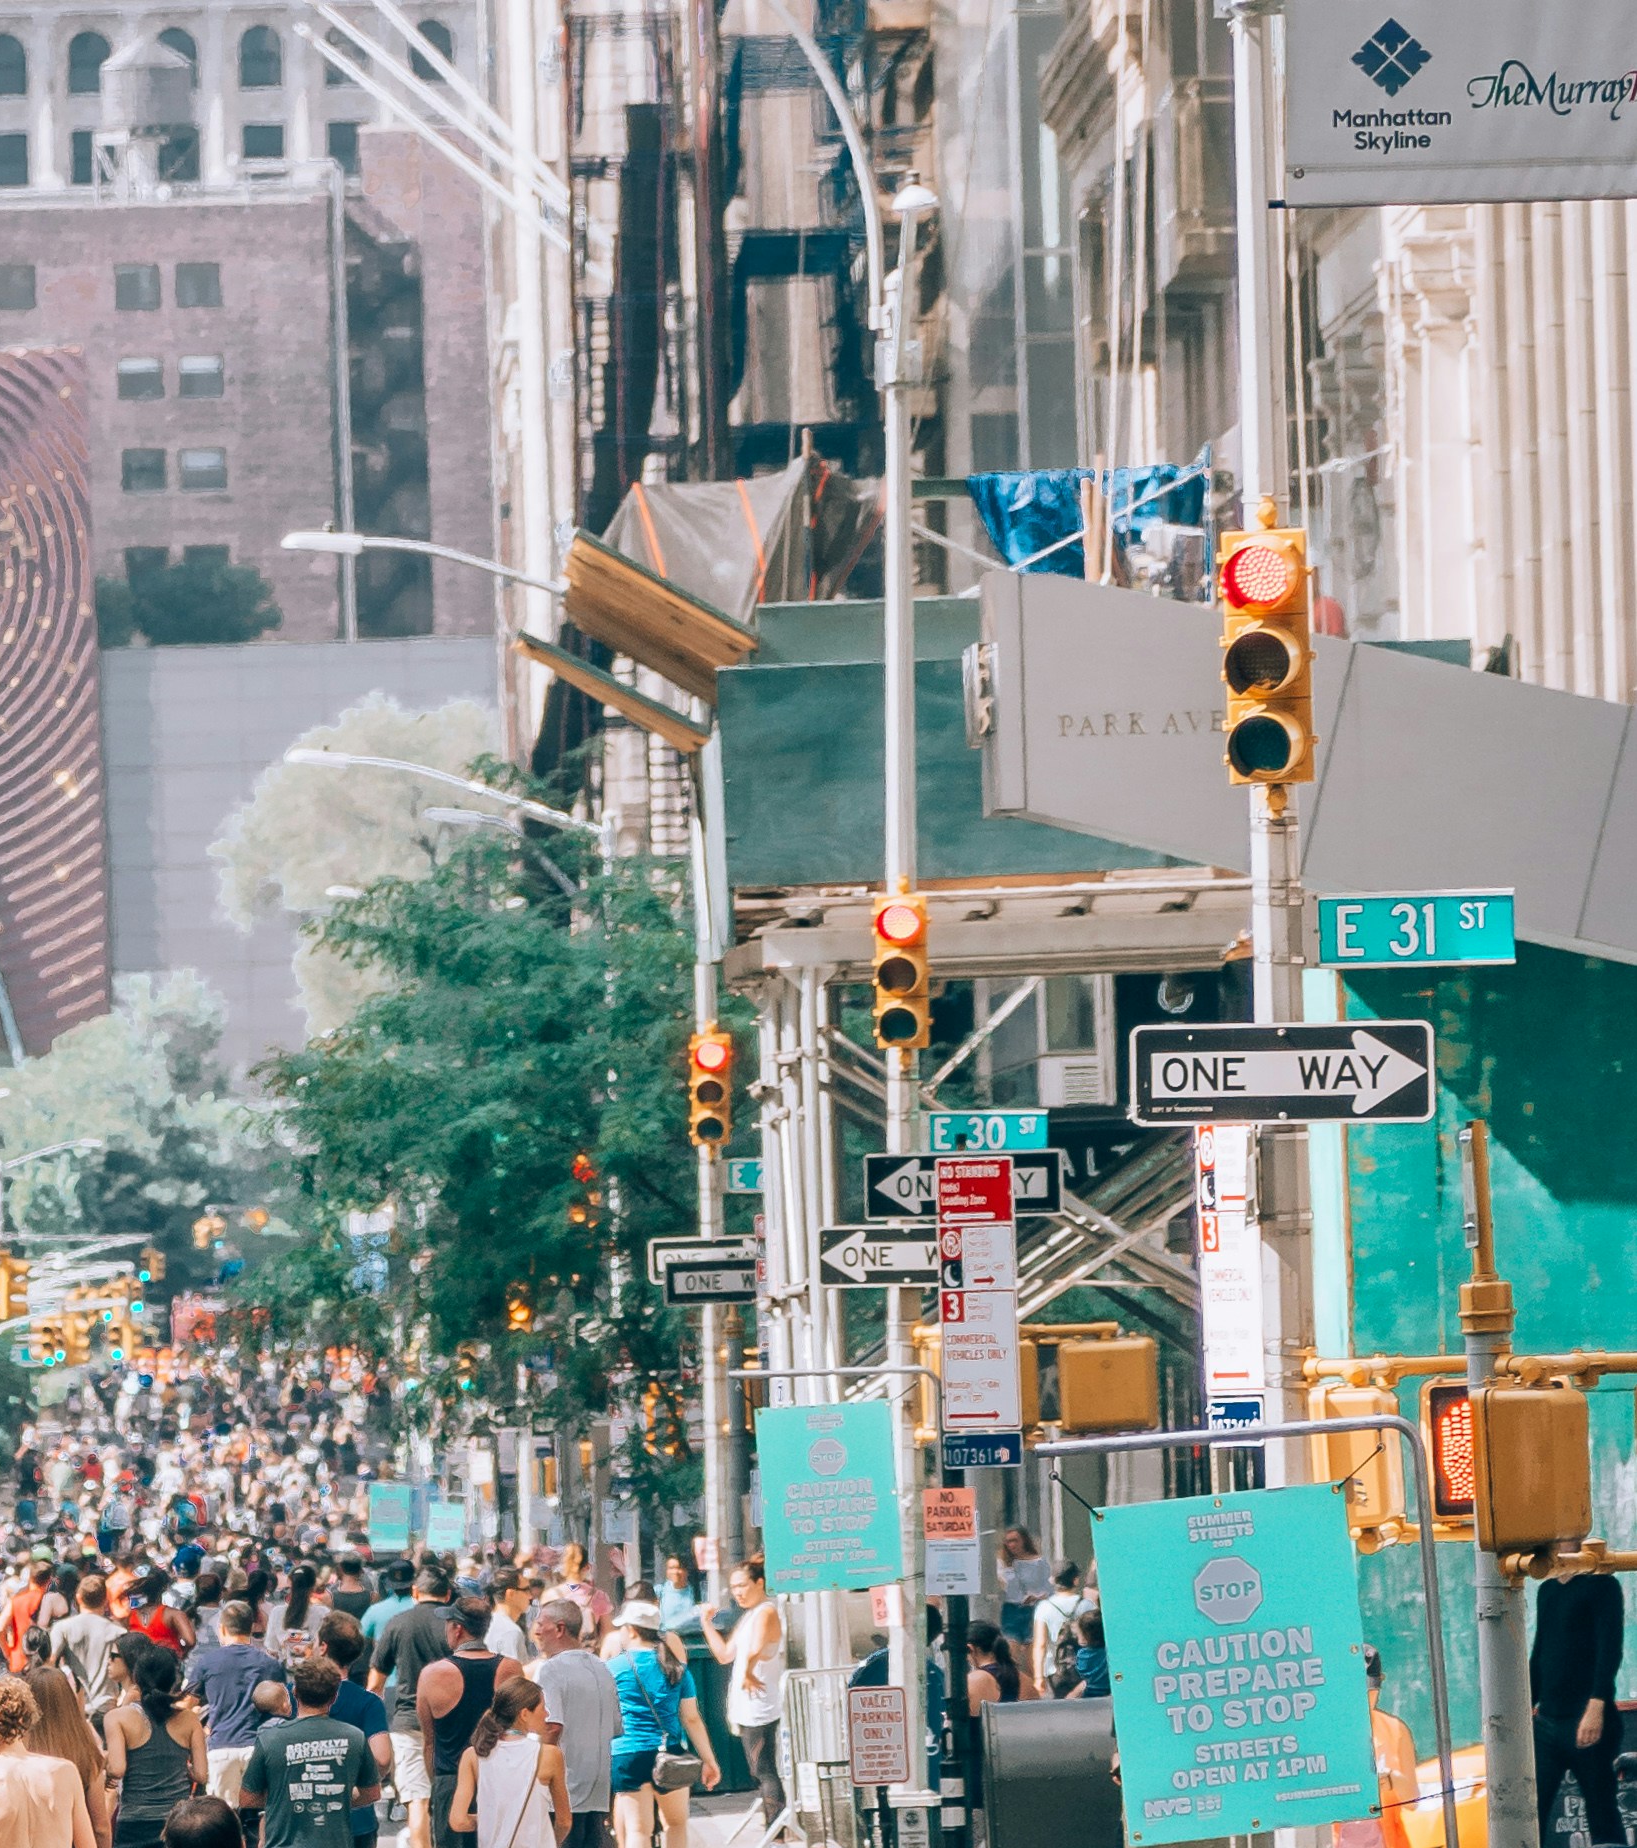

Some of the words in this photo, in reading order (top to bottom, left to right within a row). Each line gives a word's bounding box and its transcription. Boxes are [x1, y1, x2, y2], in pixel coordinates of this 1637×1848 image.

[1332, 109, 1452, 128] Manhattan
[1354, 131, 1431, 154] Skyline
[1057, 712, 1147, 737] PARK
[1337, 905, 1365, 957] E
[1389, 903, 1436, 957] 31
[1459, 902, 1489, 931] ST
[1162, 1056, 1246, 1092] ONE
[1298, 1054, 1390, 1091] WAY
[934, 1117, 952, 1150] E
[965, 1116, 1007, 1150] 30
[1019, 1117, 1036, 1135] ST
[732, 1163, 746, 1188] E
[897, 1175, 934, 1199] ON
[1206, 1217, 1217, 1249] 3
[842, 1246, 893, 1268] ONE
[685, 1273, 723, 1291] ONE
[946, 1293, 960, 1320] 3
[812, 1452, 843, 1463] STOP
[786, 1478, 873, 1499] CAUTION
[940, 1491, 955, 1503] NO
[784, 1496, 878, 1518] PREPARE
[927, 1505, 972, 1518] PARKING
[791, 1519, 816, 1535] TO
[821, 1515, 873, 1533] STOP
[926, 1521, 973, 1533] SATURDAY
[1187, 1510, 1252, 1528] SUMMER
[1189, 1522, 1255, 1542] STREETS
[1200, 1580, 1257, 1601] STOP
[1157, 1626, 1313, 1671] CAUTION
[1153, 1658, 1324, 1704] PREPARE
[860, 1695, 893, 1708] VALET
[853, 1711, 902, 1723] PARKING
[1167, 1703, 1213, 1734] TO
[1223, 1693, 1317, 1729] STOP
[863, 1727, 893, 1739] ONLY
[286, 1739, 349, 1752] BROOKLYN
[1195, 1735, 1299, 1763] STREETS
[1172, 1766, 1237, 1790] OPEN
[1243, 1761, 1269, 1782] AT
[1277, 1755, 1328, 1779] 1PM
[1144, 1797, 1192, 1819] NYC
